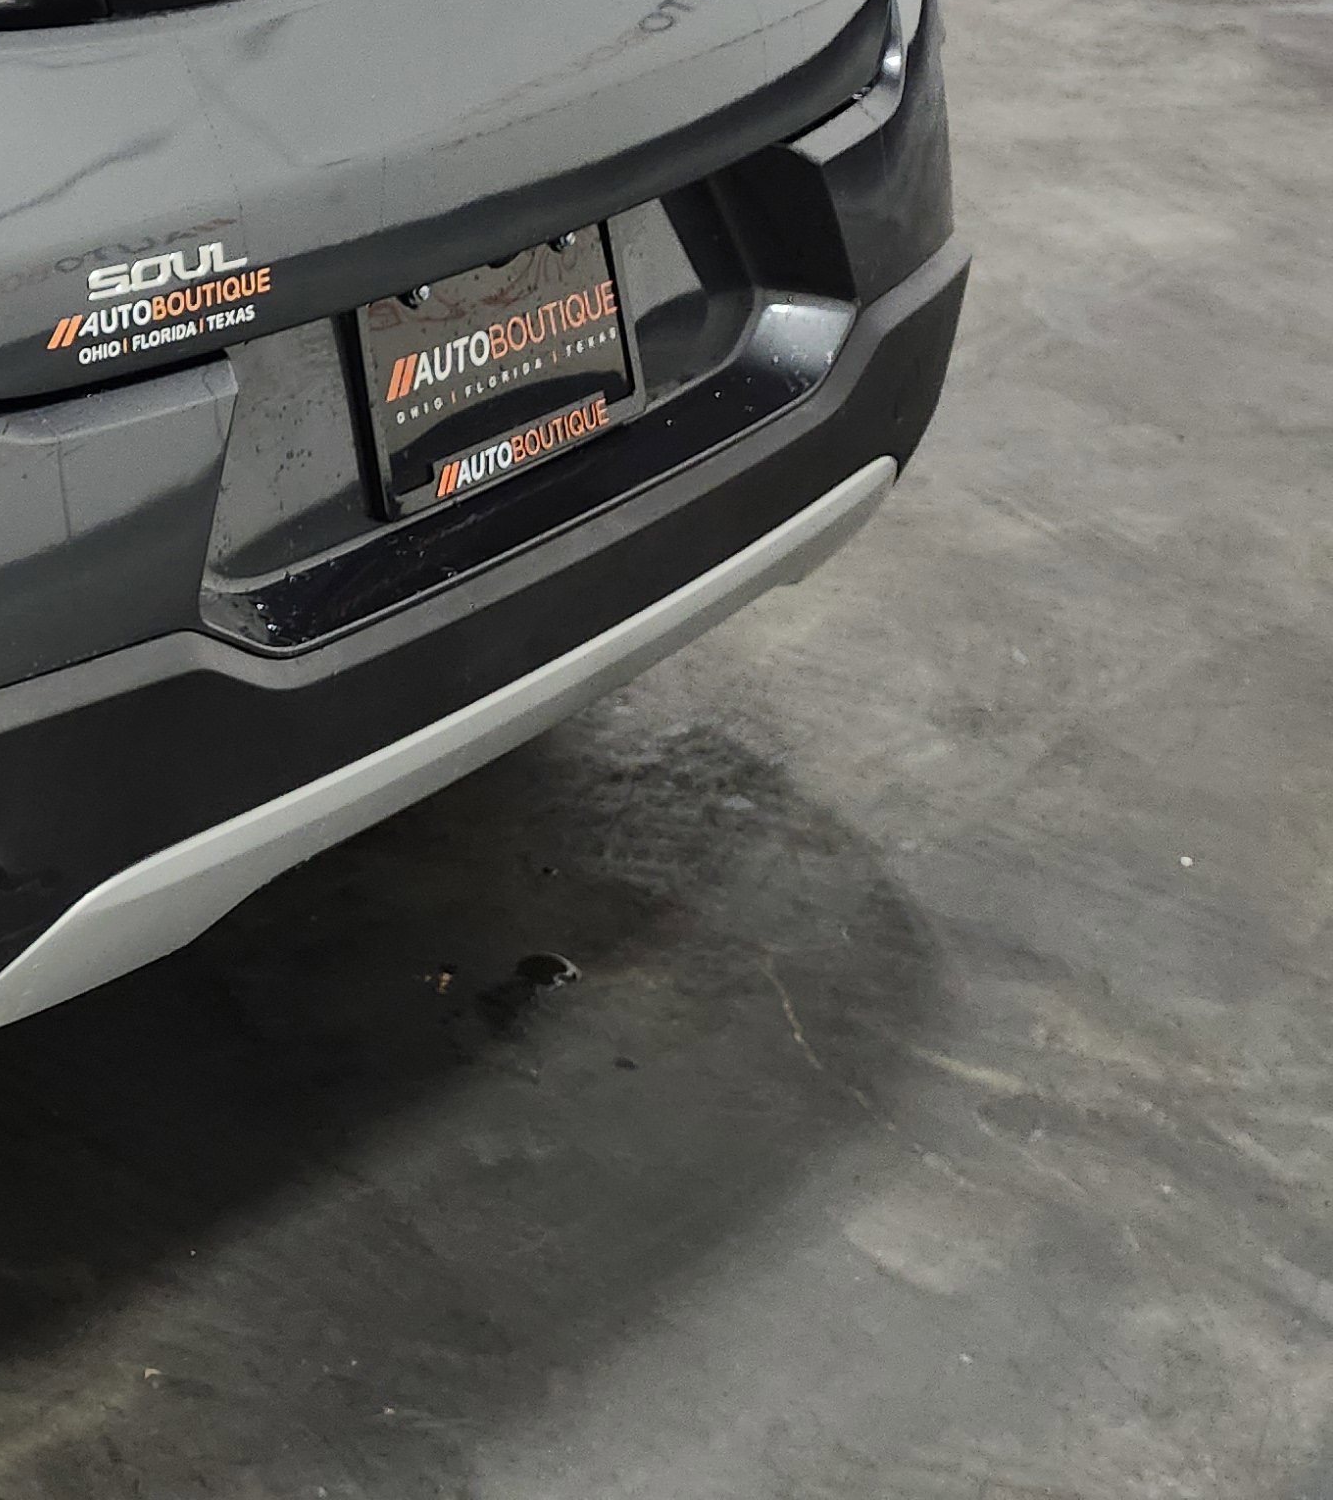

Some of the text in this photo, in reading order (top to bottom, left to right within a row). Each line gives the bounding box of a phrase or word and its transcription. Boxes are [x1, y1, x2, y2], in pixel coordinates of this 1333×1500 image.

[78, 267, 272, 337] AUTOBOUTIQUE
[87, 241, 248, 301] SOUL
[78, 303, 256, 365] OHIO FLORIDA TEXAS
[413, 279, 618, 391] AUTOBOUTIQUE
[396, 326, 618, 425] OHIO FLORIDA TEXAS
[456, 397, 611, 489] AUTOBOUTIQUE
